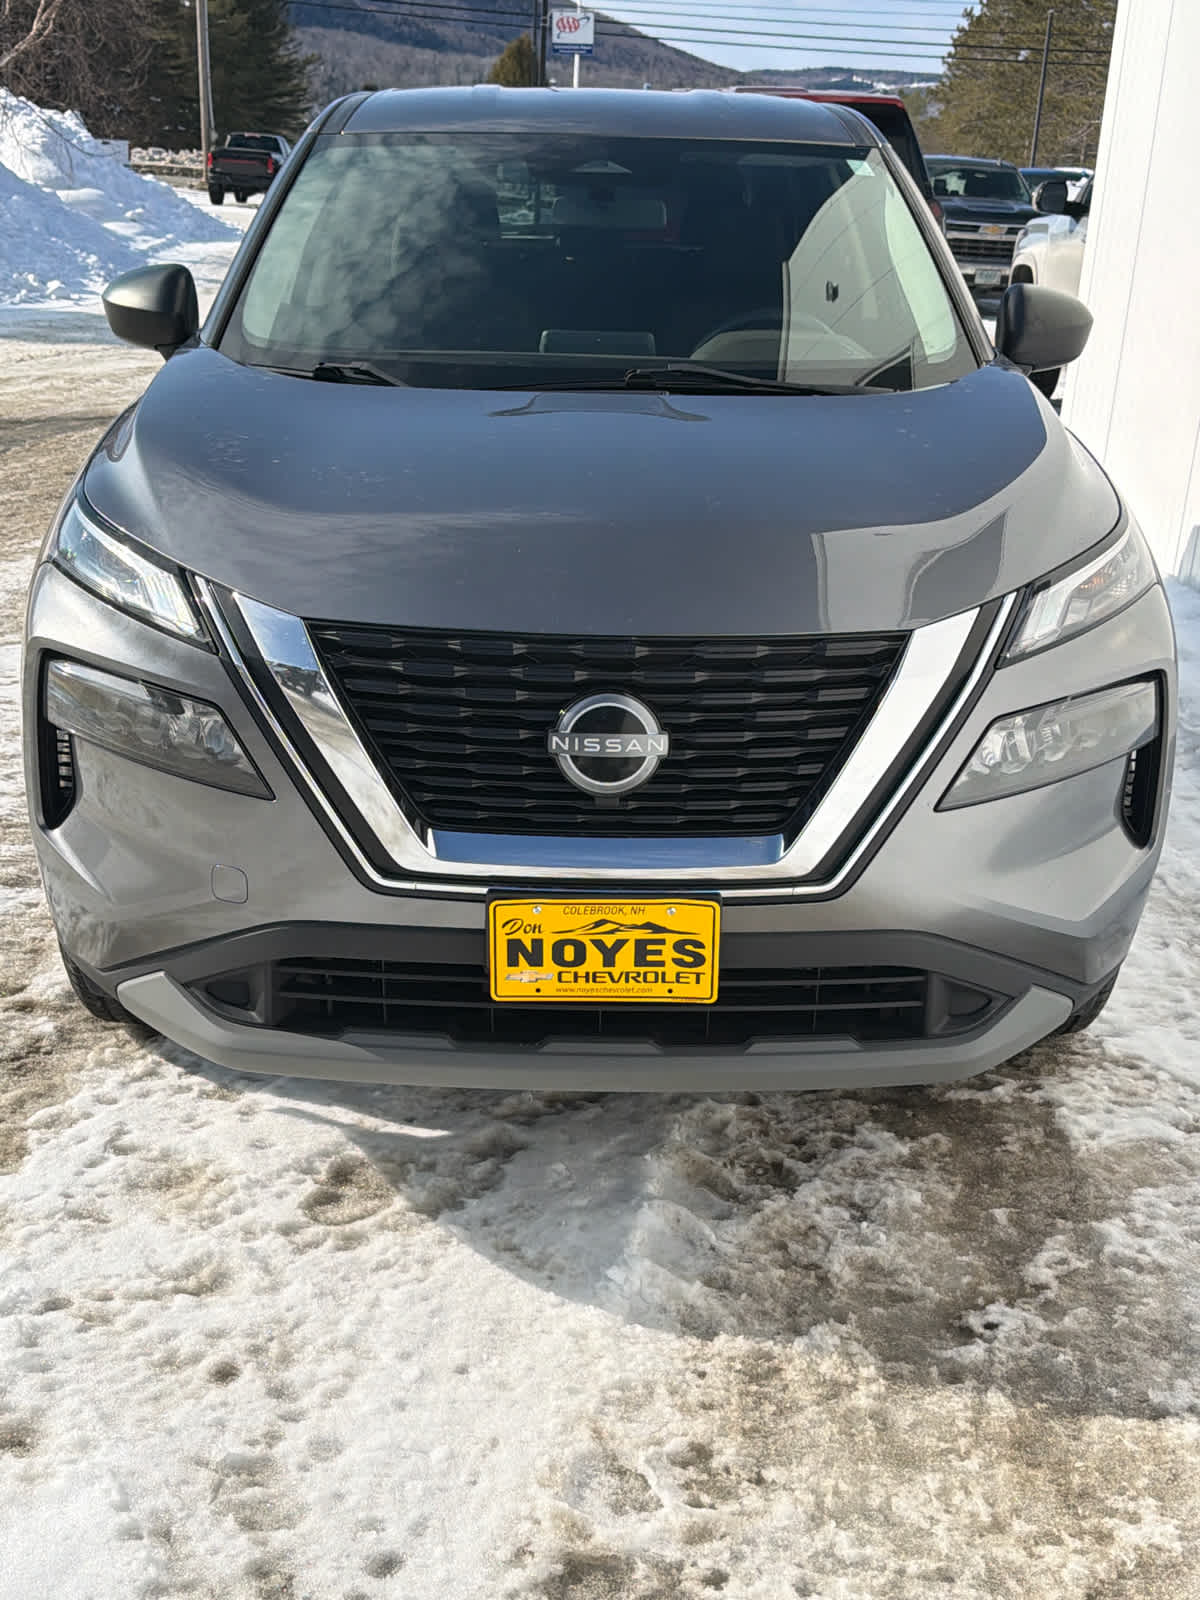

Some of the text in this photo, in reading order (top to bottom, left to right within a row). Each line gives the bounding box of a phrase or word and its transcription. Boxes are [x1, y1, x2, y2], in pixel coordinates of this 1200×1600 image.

[551, 735, 664, 753] NISSAN
[563, 905, 646, 916] COLEBROOK, NH
[501, 918, 543, 936] Don
[506, 938, 706, 968] NOYES
[557, 971, 706, 985] CHEVROLET
[555, 986, 653, 995] www.noyeschevrolet.com
